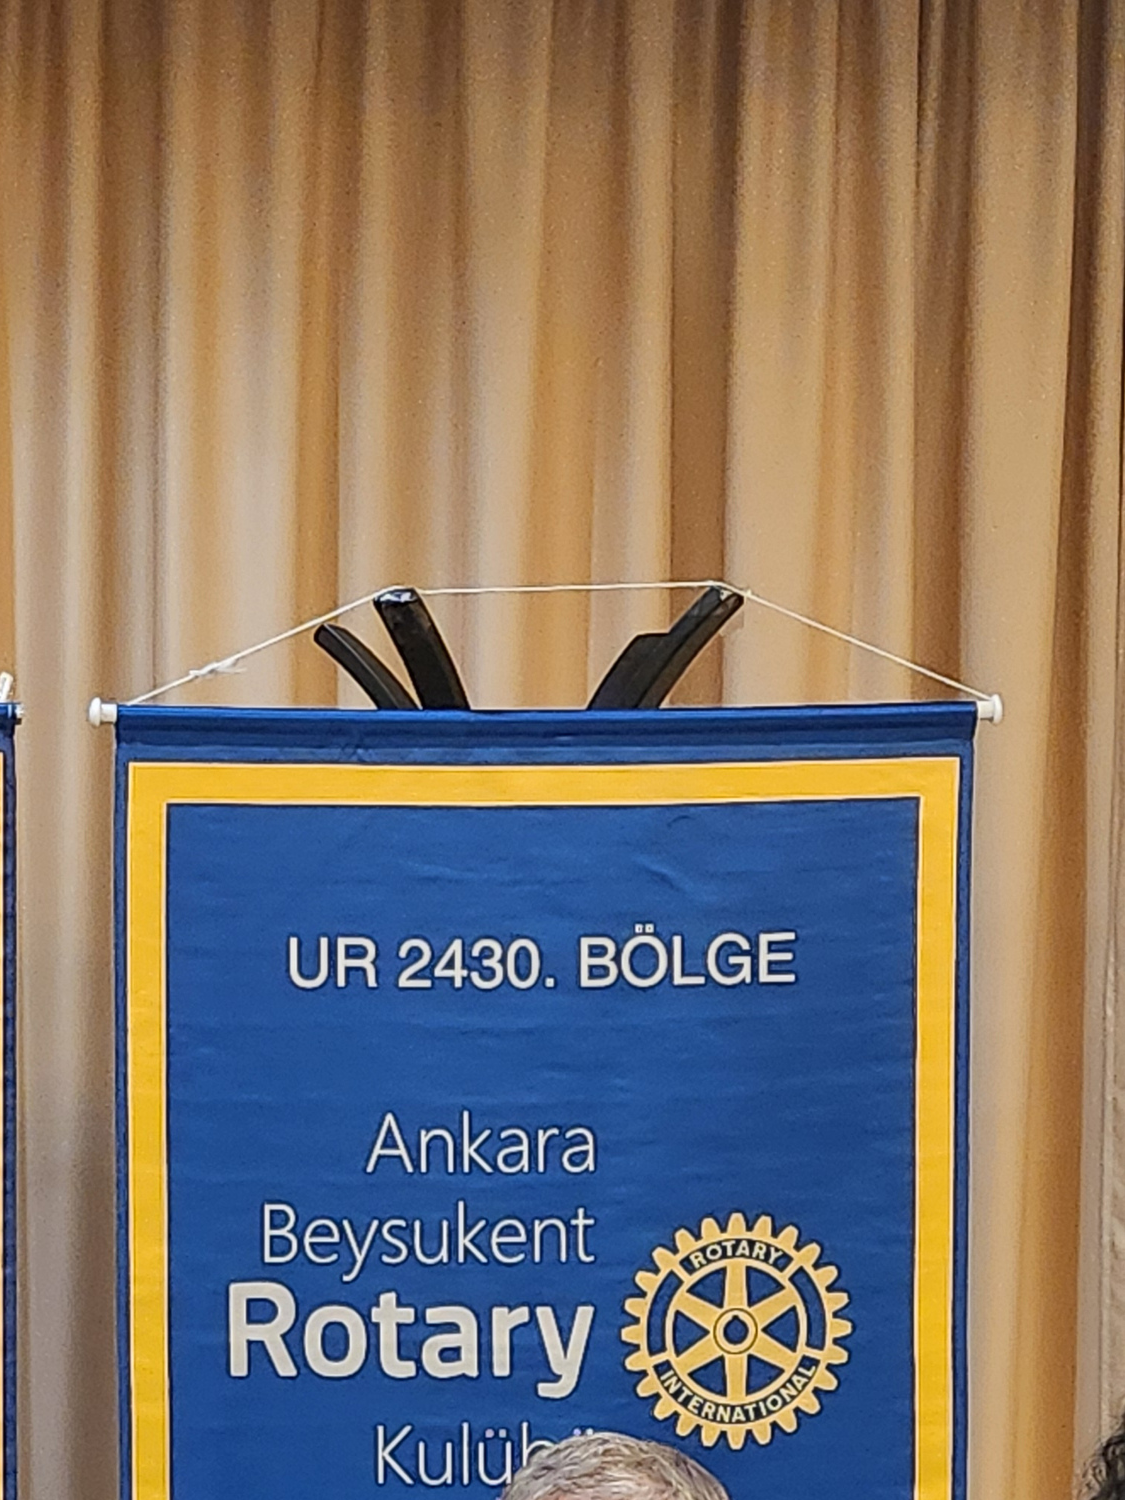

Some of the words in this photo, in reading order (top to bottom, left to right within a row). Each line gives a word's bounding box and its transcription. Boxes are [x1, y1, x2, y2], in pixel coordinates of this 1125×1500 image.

[288, 936, 378, 989] UR
[397, 938, 556, 989] 2430.
[579, 923, 797, 988] BÖLGE
[365, 1110, 596, 1173] Ankara
[263, 1201, 595, 1283] Beysukent
[688, 1239, 784, 1270] ROTARY
[228, 1281, 595, 1399] Rotary
[659, 1365, 817, 1423] INTERNATIONAL
[376, 1422, 594, 1487] Kulüb
